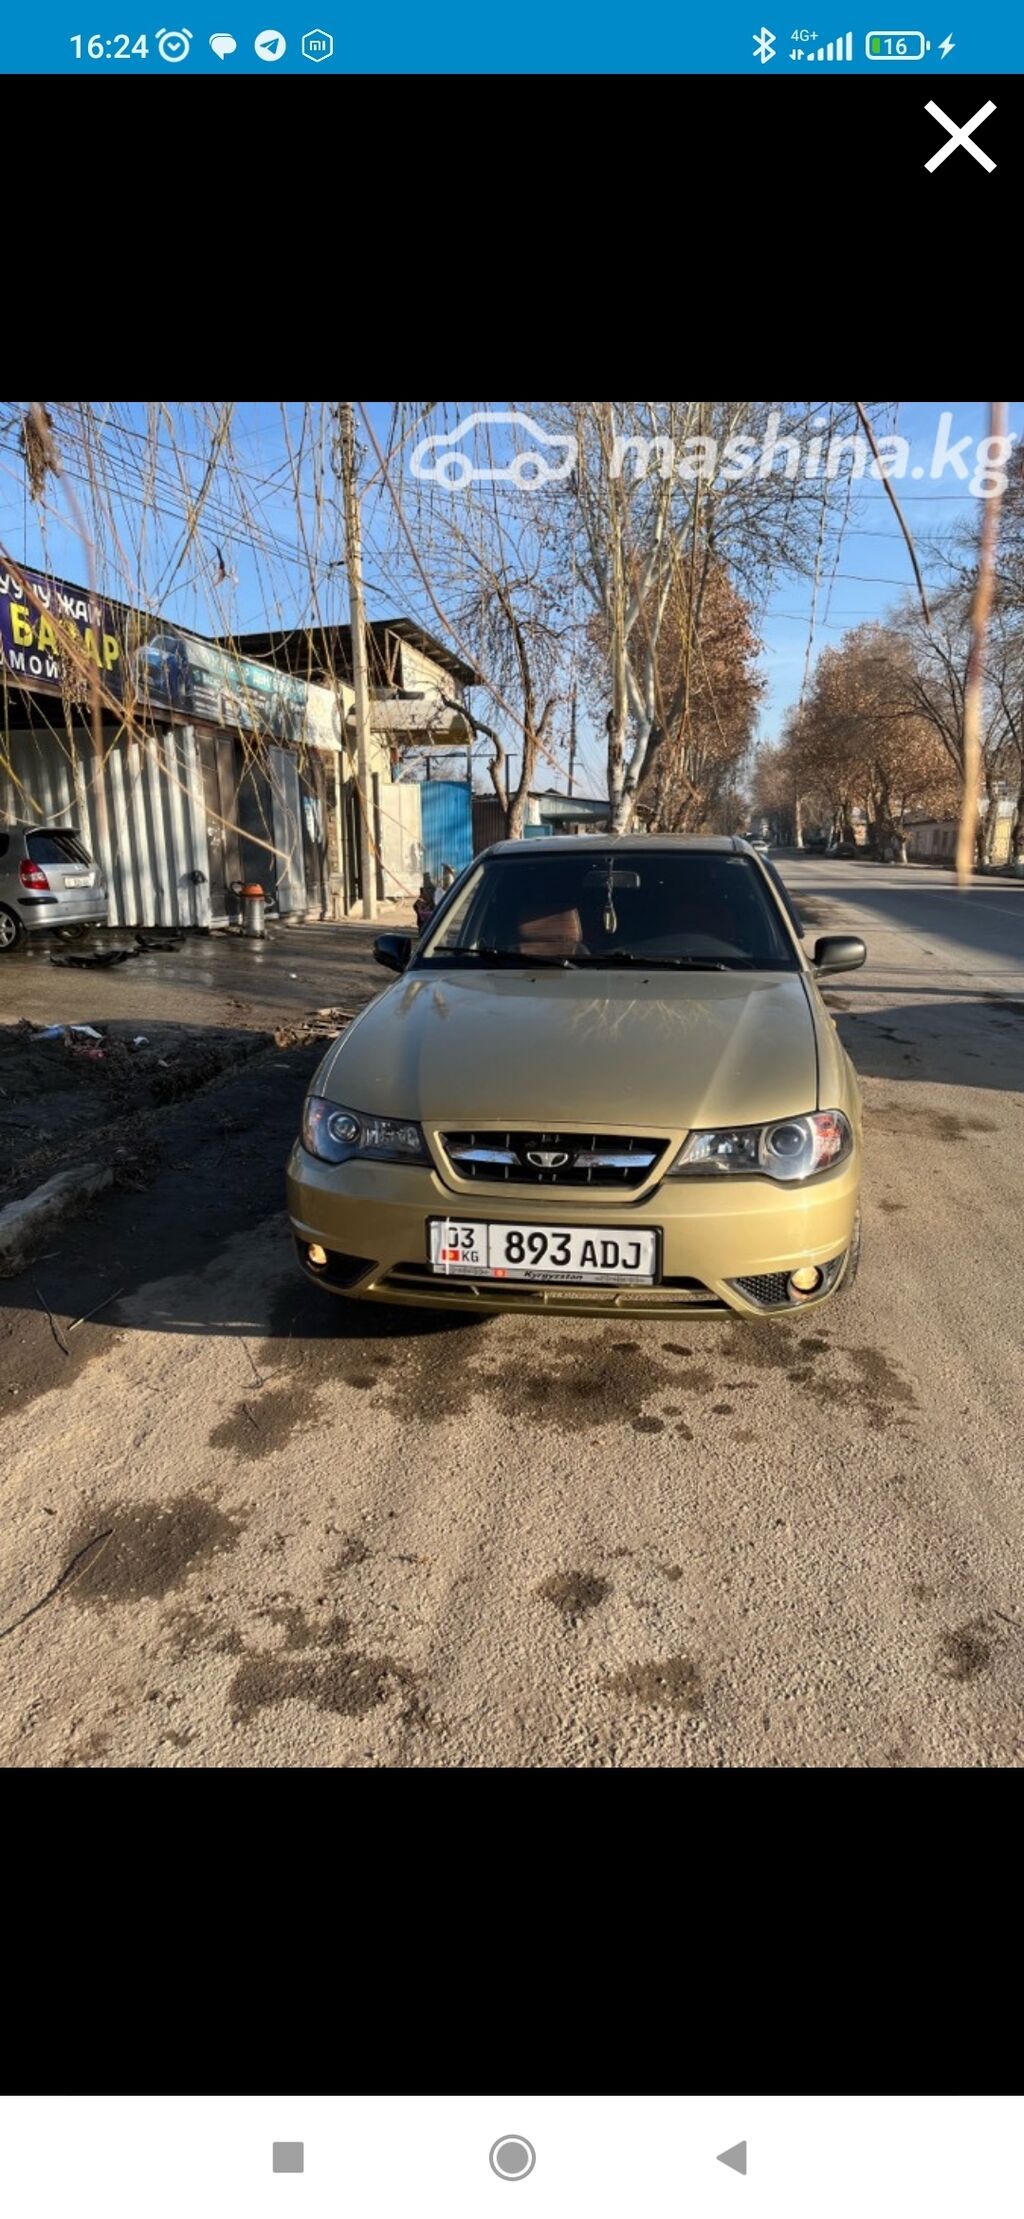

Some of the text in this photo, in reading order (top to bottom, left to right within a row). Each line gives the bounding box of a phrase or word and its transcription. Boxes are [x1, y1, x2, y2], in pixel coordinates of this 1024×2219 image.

[791, 30, 818, 42] 4G+
[70, 34, 148, 58] 16:24
[884, 38, 907, 55] 16
[461, 1250, 479, 1263] KG
[504, 1230, 572, 1266] 893
[580, 1240, 642, 1270] ADJ
